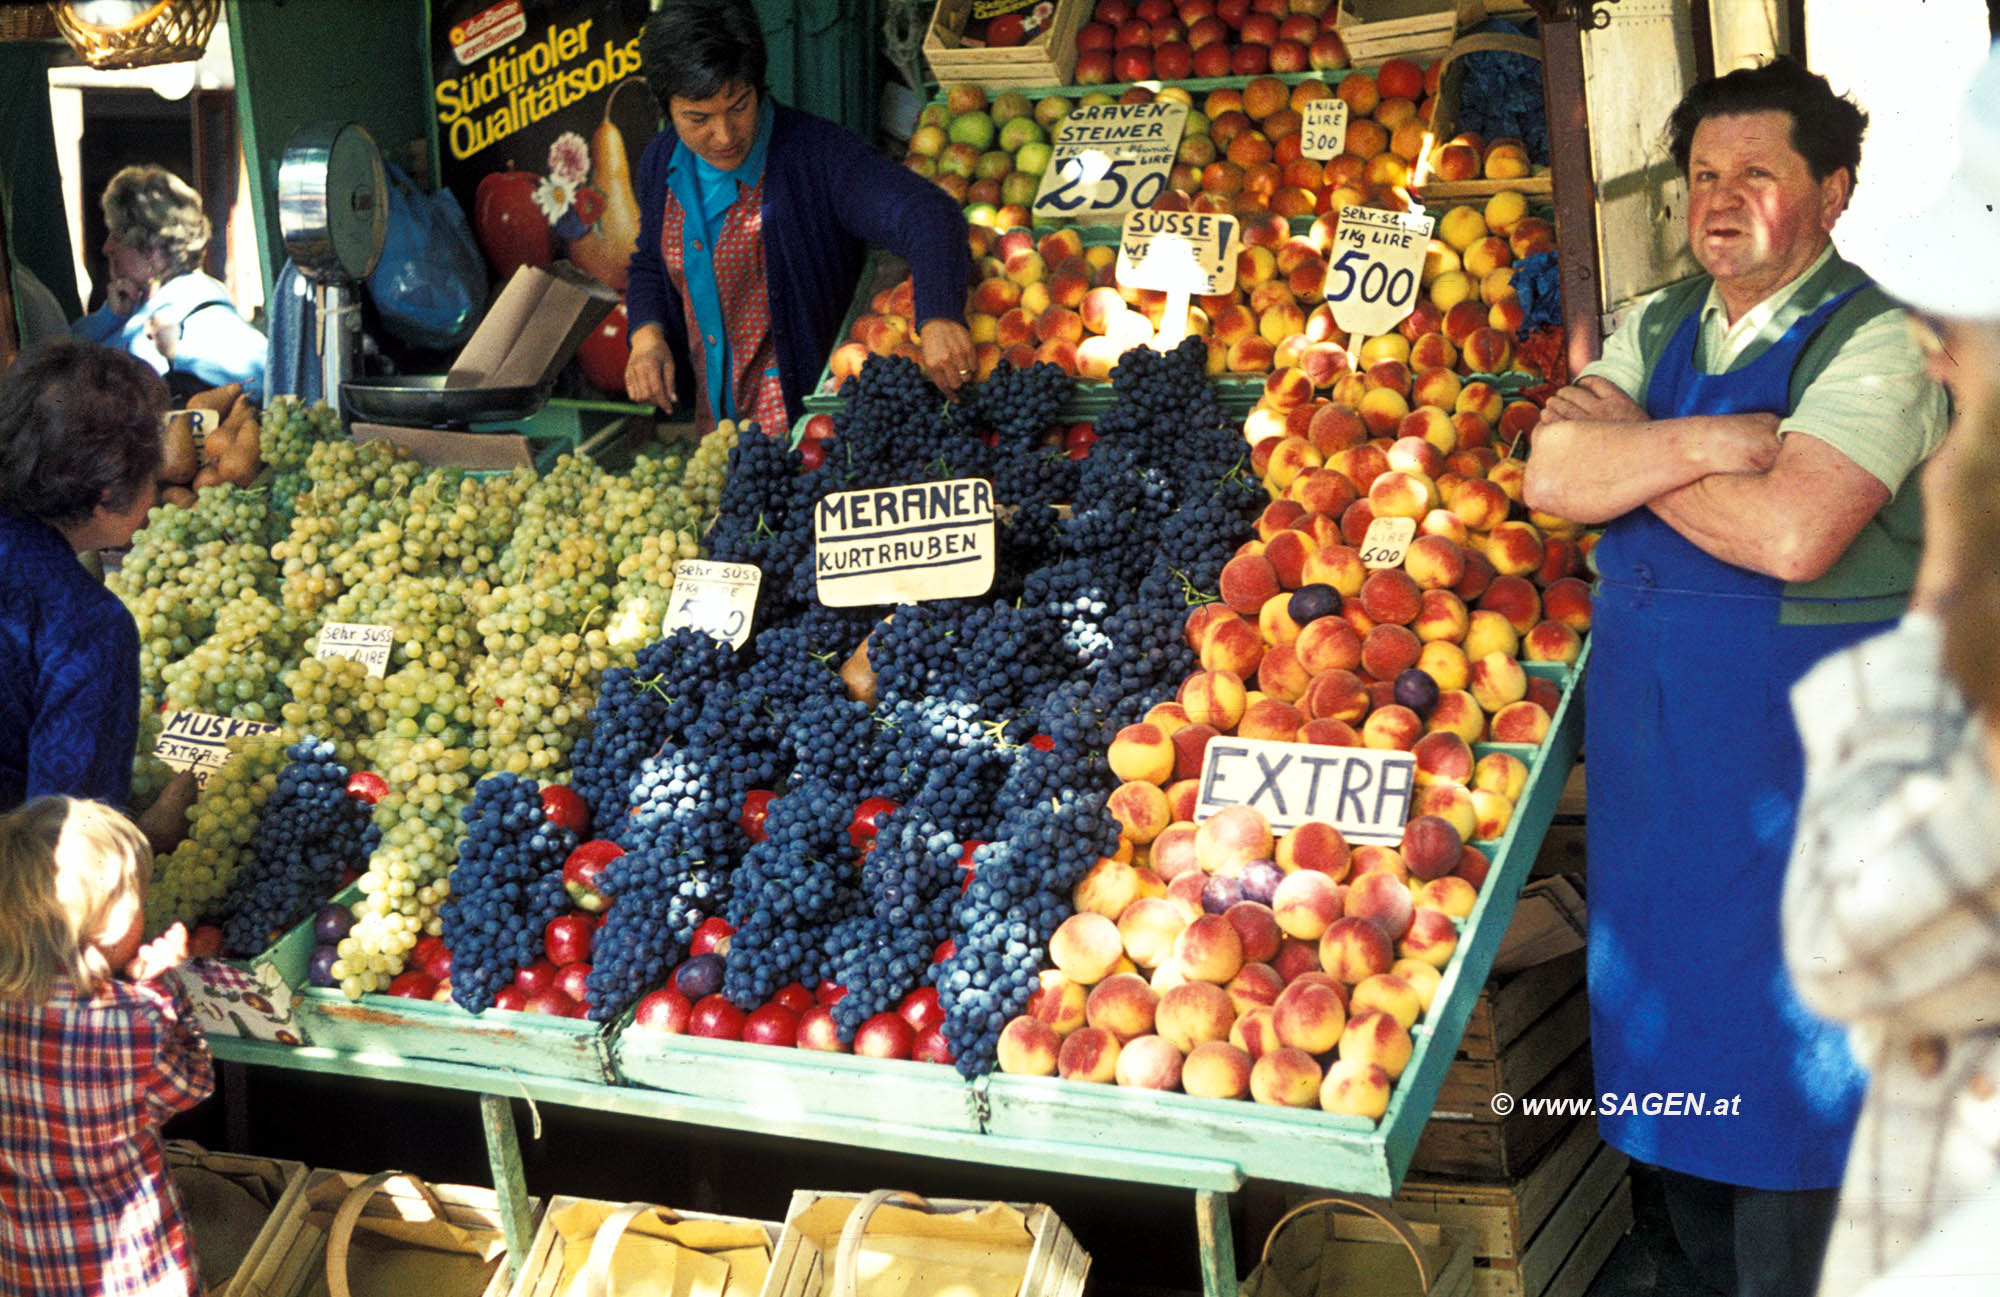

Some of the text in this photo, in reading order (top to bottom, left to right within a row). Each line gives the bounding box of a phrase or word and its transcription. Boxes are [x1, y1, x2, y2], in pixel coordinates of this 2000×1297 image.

[435, 18, 593, 124] Südtiroler
[1058, 122, 1163, 142] STEINER
[1308, 114, 1342, 126] LIRE
[1303, 130, 1338, 151] 300
[1140, 154, 1173, 166] LIRE
[1035, 157, 1168, 211] 250
[1129, 211, 1212, 237] SÜSSE
[1371, 231, 1413, 249] LIRE
[1326, 250, 1415, 307] 500
[820, 481, 995, 532] MERANER
[818, 532, 977, 572] KURTRAUBEN
[1362, 547, 1400, 563] 600
[1202, 746, 1417, 828] EXTRA
